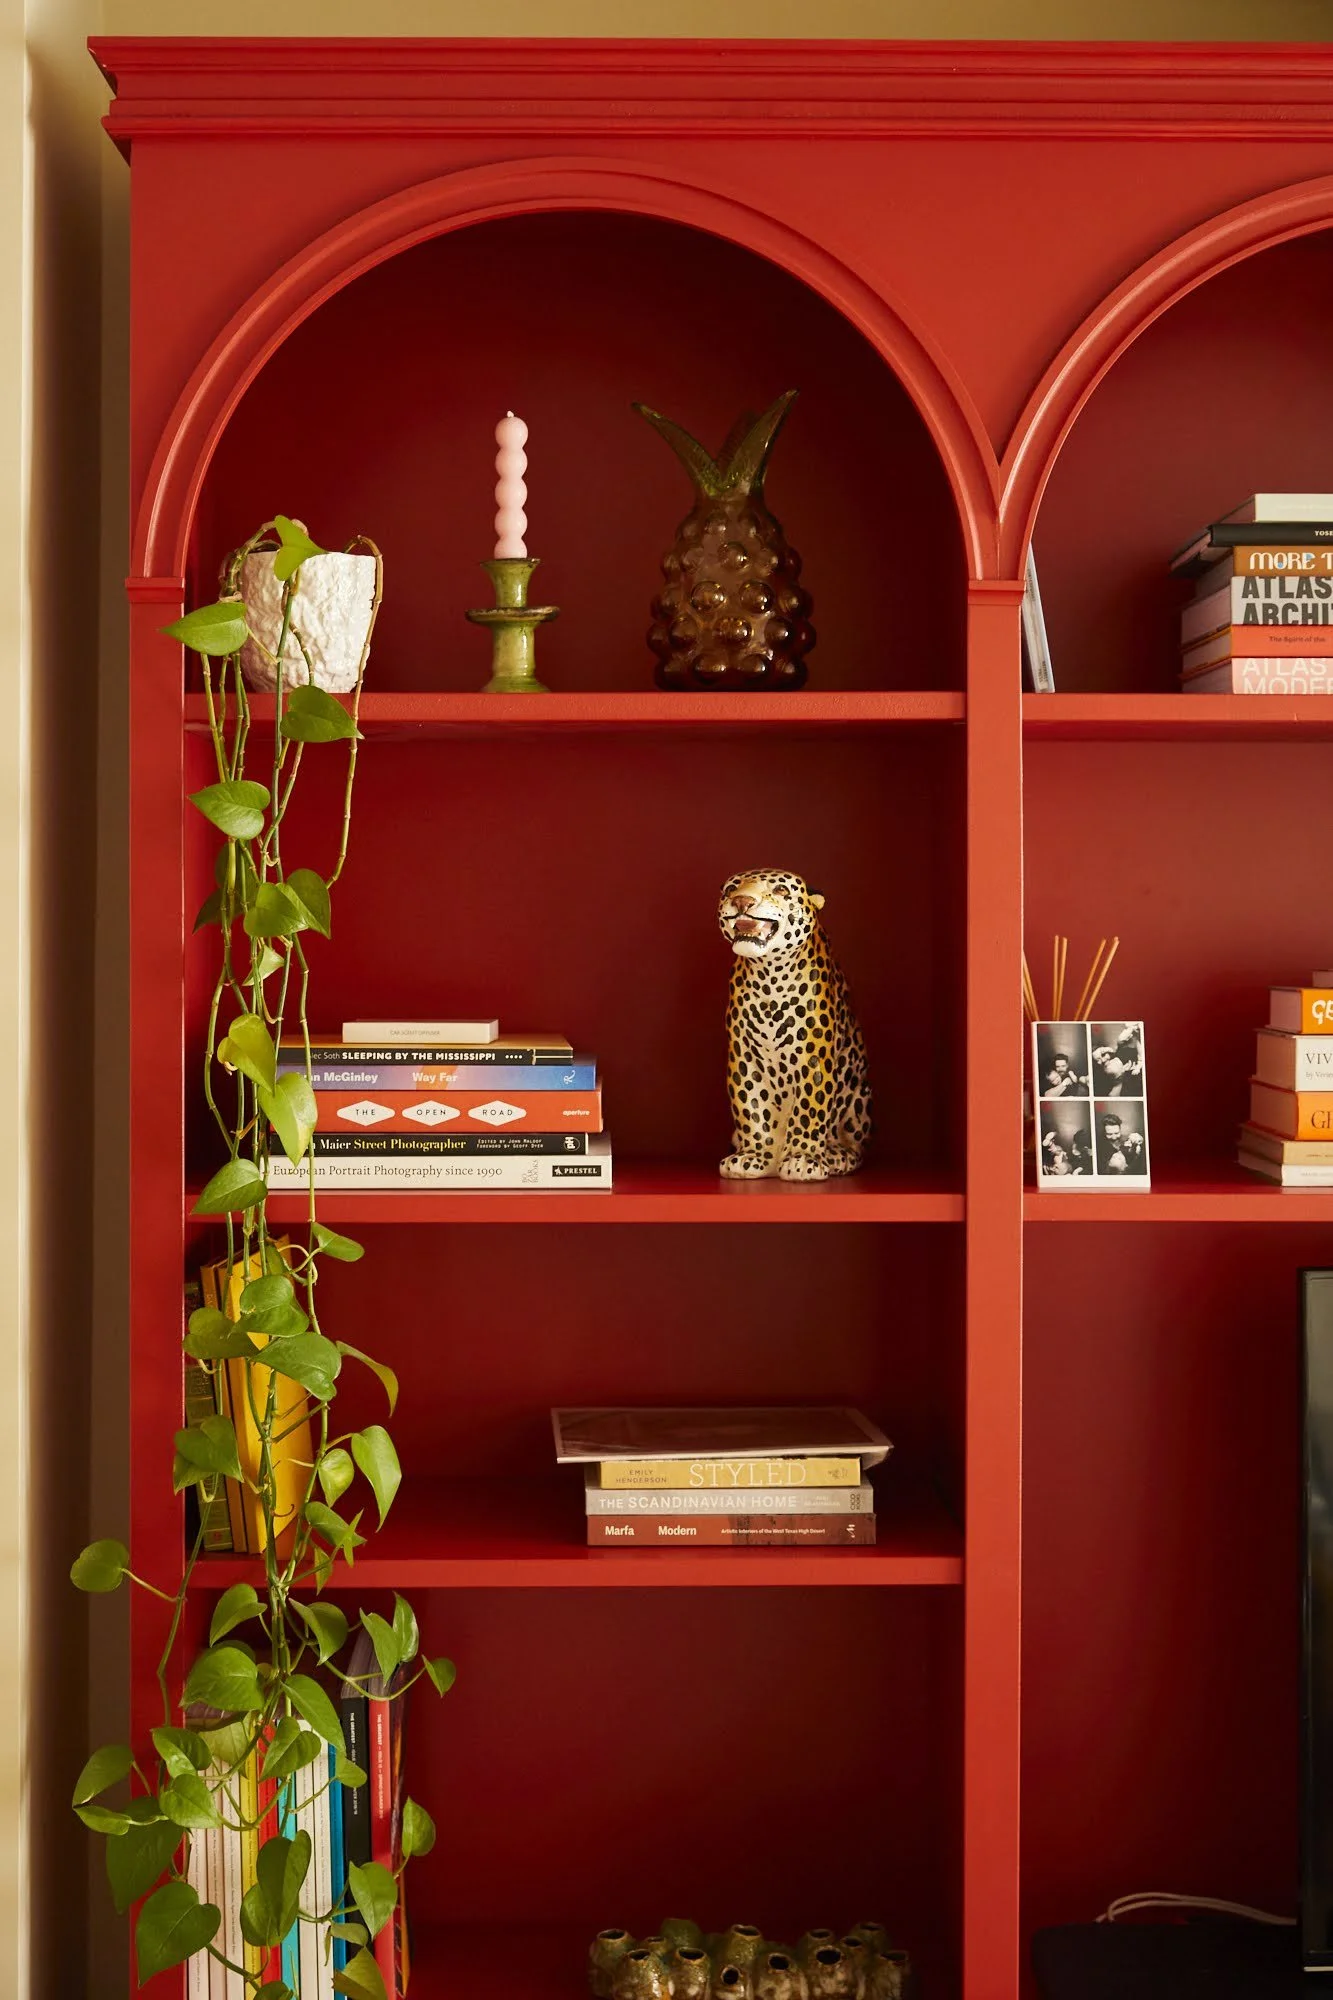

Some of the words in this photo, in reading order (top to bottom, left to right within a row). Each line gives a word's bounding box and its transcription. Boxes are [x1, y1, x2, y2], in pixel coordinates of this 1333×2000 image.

[1250, 552, 1315, 570] MORE
[1242, 576, 1332, 599] ATLAS
[1243, 603, 1333, 624] ARCHI
[1241, 657, 1328, 676] ATLAS
[323, 1051, 340, 1060] Soth
[342, 1052, 392, 1060] SLEEPING
[395, 1052, 409, 1061] BY
[411, 1052, 433, 1061] THE
[435, 1052, 496, 1061] MISSISSIPPI
[323, 1071, 378, 1084] McGinley
[412, 1071, 436, 1084] Way
[439, 1072, 458, 1082] Far
[562, 1109, 590, 1117] aperture
[320, 1138, 351, 1150] Maier
[353, 1138, 387, 1150] Street
[390, 1138, 467, 1153] Photographer
[329, 1165, 371, 1176] Portrait
[374, 1165, 443, 1178] Photography
[445, 1165, 474, 1176] since
[477, 1167, 503, 1178] 1990
[564, 1167, 598, 1175] PRESTEL
[689, 1462, 807, 1487] STYLED
[599, 1498, 624, 1509] THE
[627, 1496, 746, 1509] SCANDINAVIAN
[751, 1495, 797, 1508] HOME
[605, 1525, 635, 1536] Marfa
[658, 1525, 697, 1536] Modern
